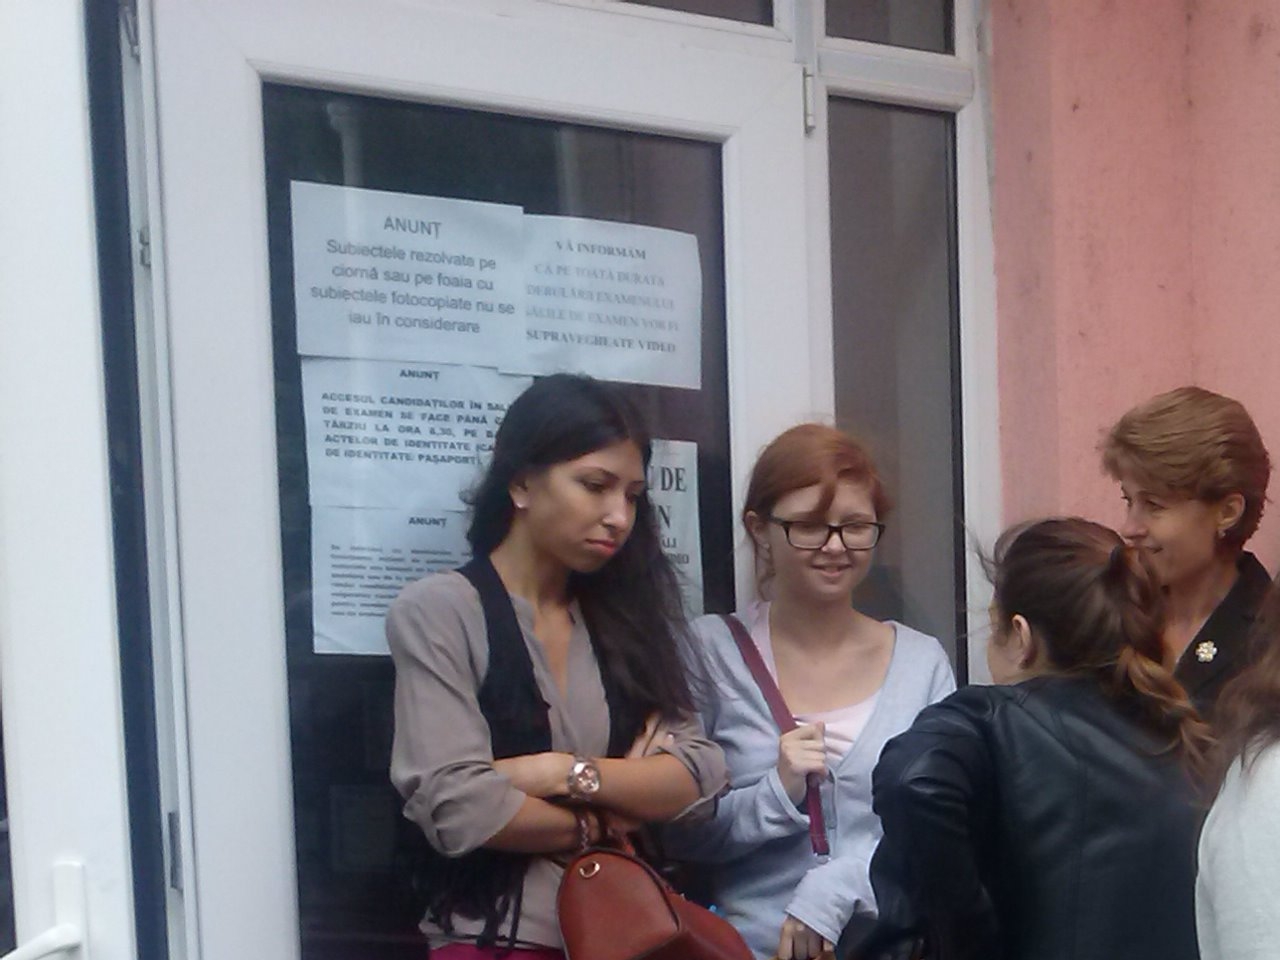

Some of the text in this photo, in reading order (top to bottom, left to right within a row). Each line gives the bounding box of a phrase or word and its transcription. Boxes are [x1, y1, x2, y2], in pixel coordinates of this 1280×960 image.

[326, 239, 496, 271] Subiectele rezolvate pe
[383, 270, 410, 283] sau
[415, 273, 433, 286] pe
[437, 272, 472, 288] foaia
[476, 278, 494, 290] cu
[310, 285, 515, 315] subiectele fotocopiate nu se
[348, 311, 371, 325] iau
[395, 316, 480, 333] considerare
[321, 392, 375, 404] ACCESUL
[322, 406, 337, 415] DE
[345, 407, 393, 419] EXAMEN
[400, 411, 414, 420] SE
[420, 413, 450, 422] FACE
[375, 423, 389, 432] LA
[398, 424, 421, 434] ORA
[464, 429, 477, 438] PE
[324, 434, 378, 446] ACTELOR
[384, 437, 399, 446] DE
[404, 439, 471, 451] IDENTITATE
[325, 448, 340, 457] DE
[660, 466, 687, 492] DE
